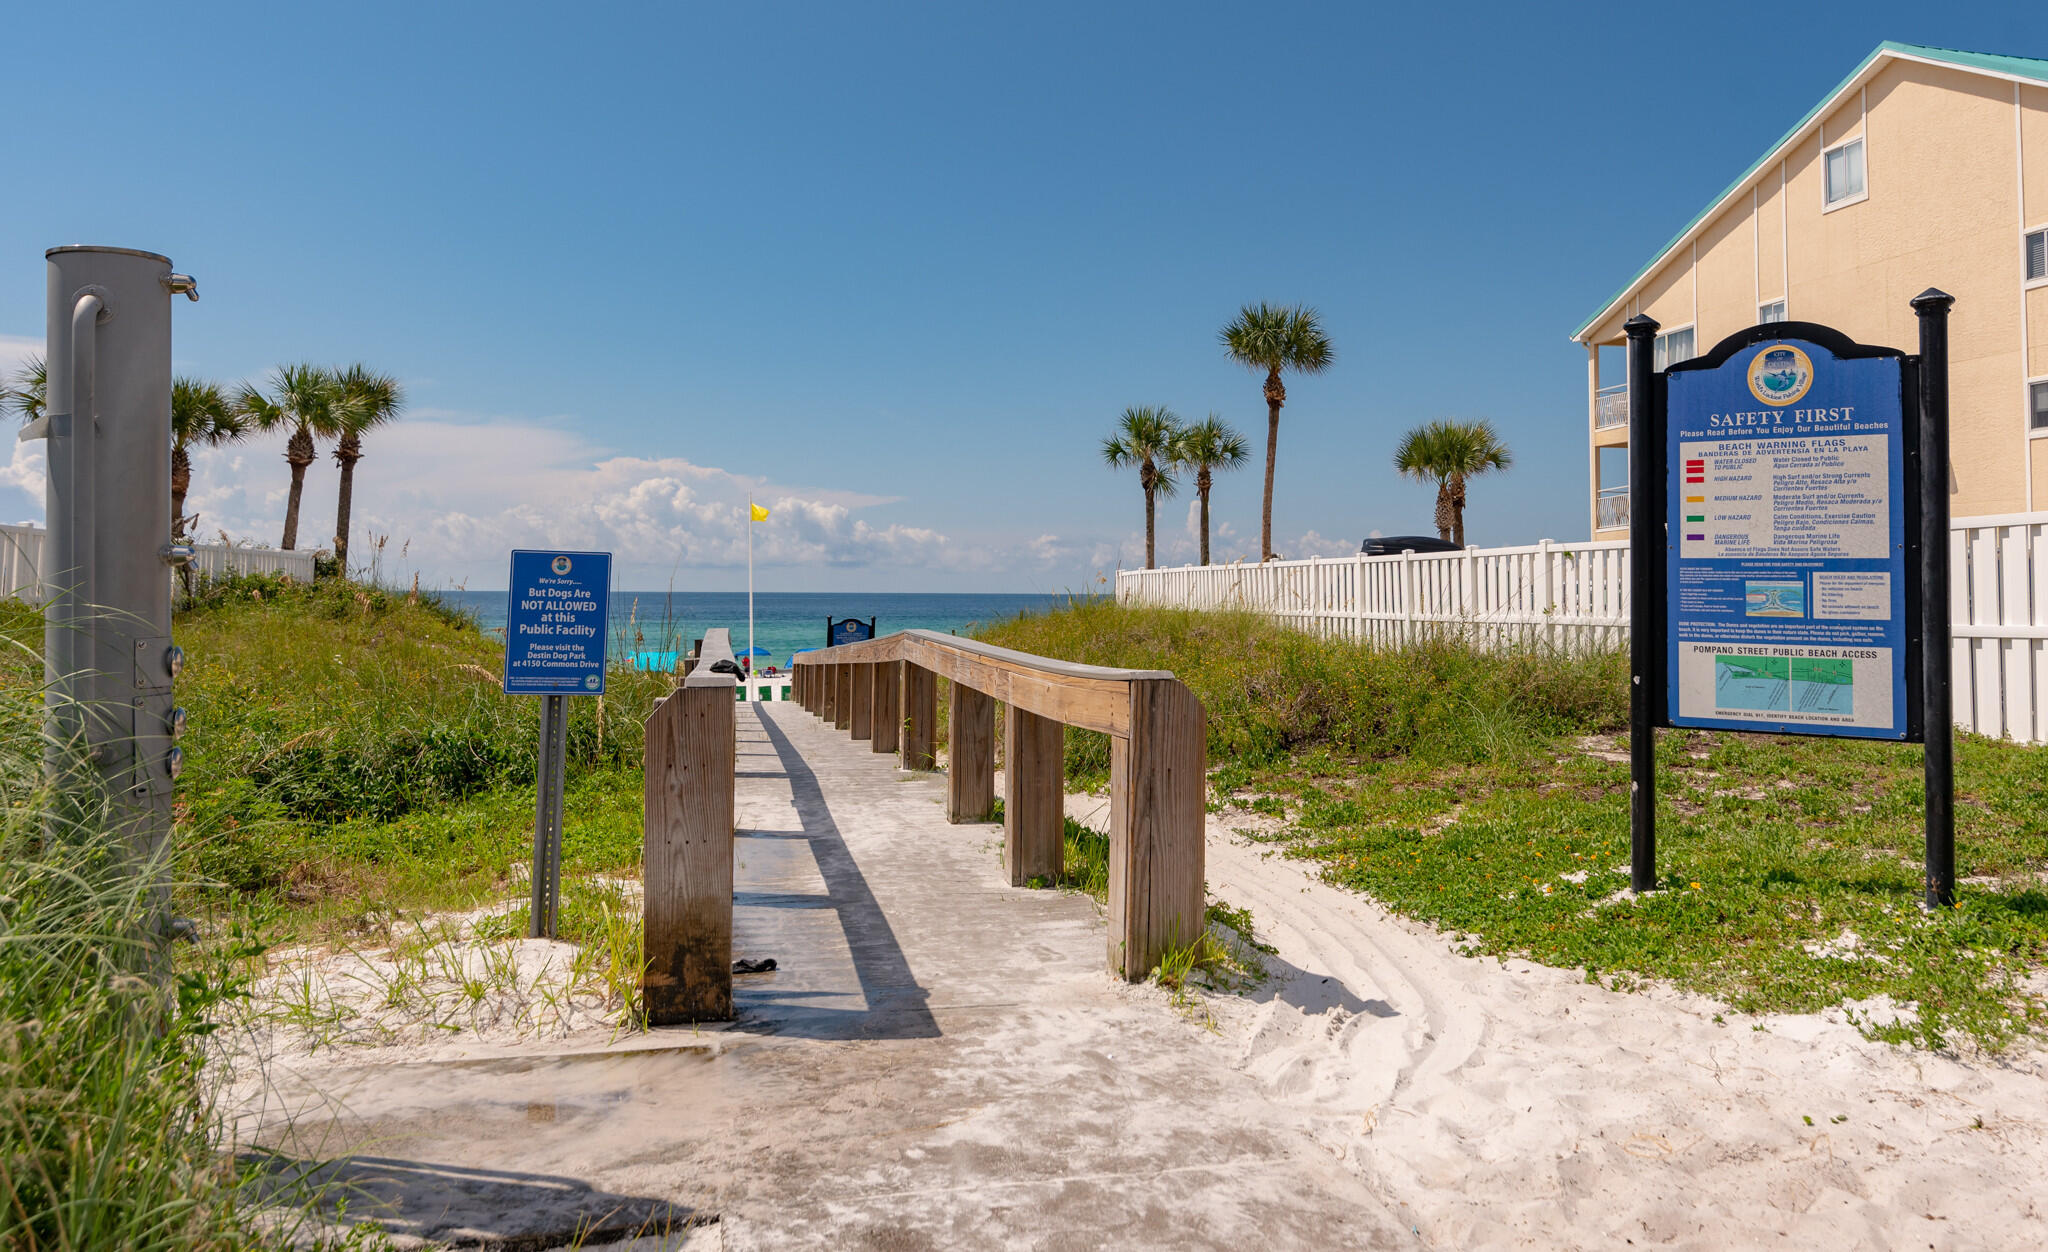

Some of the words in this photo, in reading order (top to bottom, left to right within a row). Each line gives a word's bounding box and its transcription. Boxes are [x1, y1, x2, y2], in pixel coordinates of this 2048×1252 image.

[1710, 411, 1784, 427] SAFETY
[1794, 407, 1854, 423] FIRST
[1773, 426, 1793, 434] Enjoy
[1757, 440, 1806, 449] WARNING
[1812, 439, 1846, 447] FLAGS
[529, 588, 546, 597] But
[548, 588, 572, 600] Dogs
[574, 589, 590, 598] Are
[521, 600, 544, 610] NOT
[545, 601, 597, 611] ALLOWED
[541, 613, 552, 622] at
[555, 612, 575, 622] this
[520, 624, 553, 634] Public
[556, 625, 596, 637] Facility
[553, 652, 567, 660] Dog
[1694, 646, 1733, 654] POMPANO
[1737, 647, 1768, 655] STREET
[1773, 648, 1804, 656] PUBLIC
[1842, 650, 1877, 659] ACCESS
